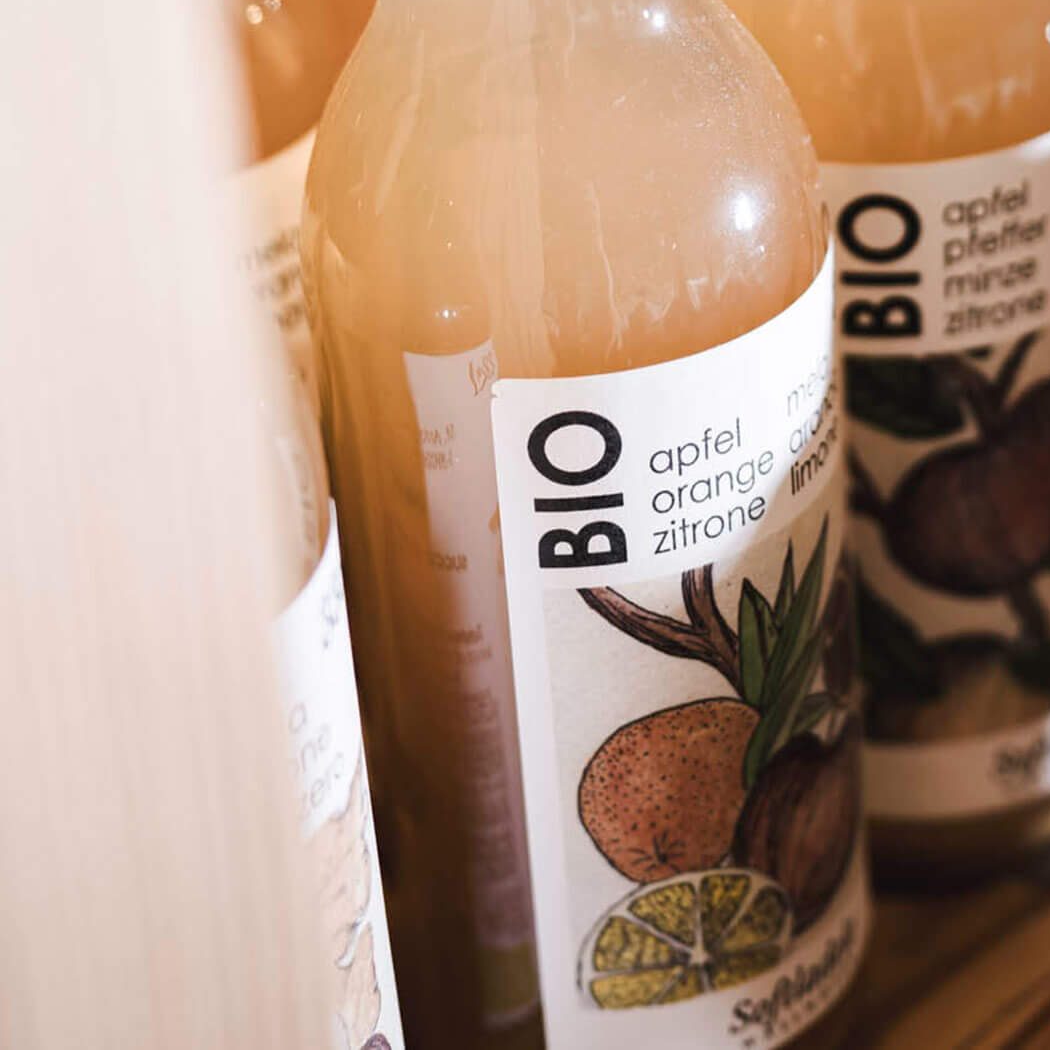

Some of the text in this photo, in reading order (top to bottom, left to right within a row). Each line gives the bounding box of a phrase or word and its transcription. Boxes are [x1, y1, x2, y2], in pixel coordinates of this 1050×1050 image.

[942, 181, 1029, 230] apfel
[838, 194, 922, 337] BIO
[942, 214, 1046, 266] pfeffer
[943, 257, 1037, 297] minze
[944, 289, 1046, 336] zitrone
[649, 417, 741, 476] apfel
[527, 410, 628, 568] BIO
[651, 450, 774, 513] orange
[653, 496, 766, 555] zitrone
